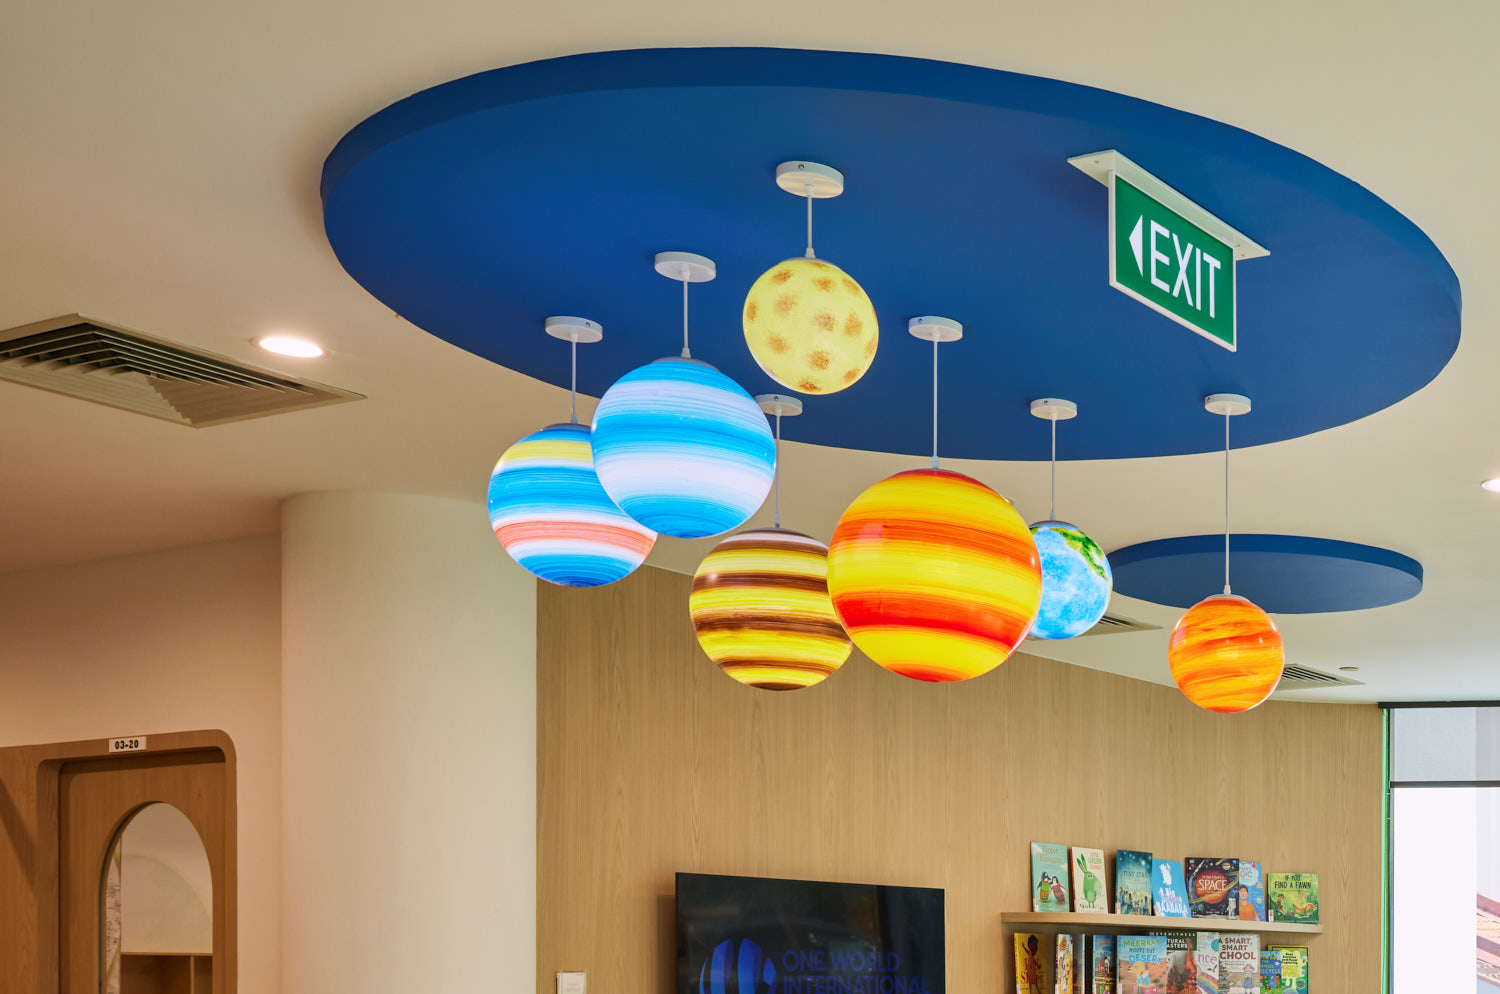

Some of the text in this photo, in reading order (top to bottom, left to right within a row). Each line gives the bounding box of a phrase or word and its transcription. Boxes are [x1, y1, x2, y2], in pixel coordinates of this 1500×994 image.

[1150, 219, 1221, 319] EXIT
[114, 739, 139, 750] 03-20
[1198, 879, 1227, 890] SPACE
[1274, 881, 1288, 889] FIND
[1295, 881, 1312, 889] FAWN
[1122, 939, 1161, 947] MEERKAT
[782, 950, 900, 972] ONE WORLD
[1128, 954, 1163, 964] DESERT
[1219, 952, 1257, 960] CHOOL
